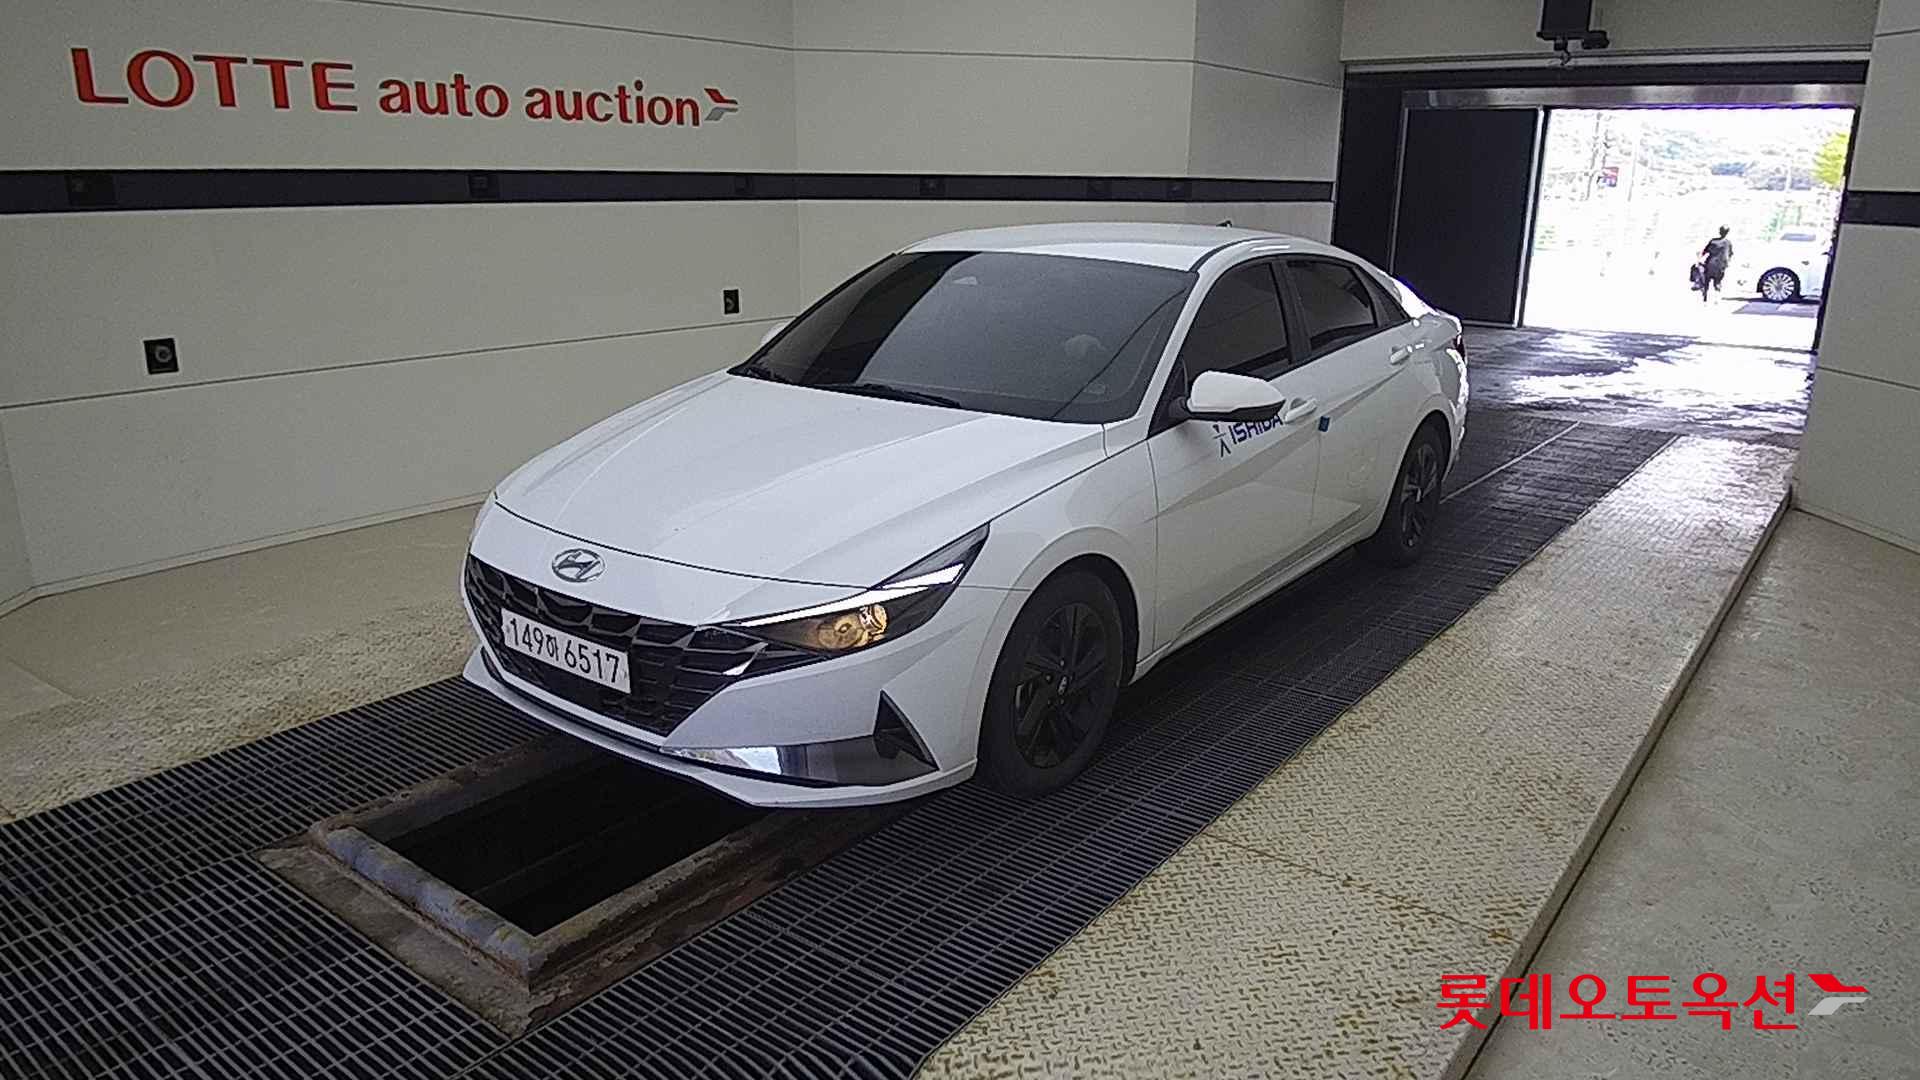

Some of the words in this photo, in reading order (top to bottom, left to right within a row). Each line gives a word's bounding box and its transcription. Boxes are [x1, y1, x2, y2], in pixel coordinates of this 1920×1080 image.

[70, 47, 358, 113] LOTTE
[379, 74, 509, 119] auto
[524, 79, 701, 127] auction
[564, 639, 620, 684] 6517
